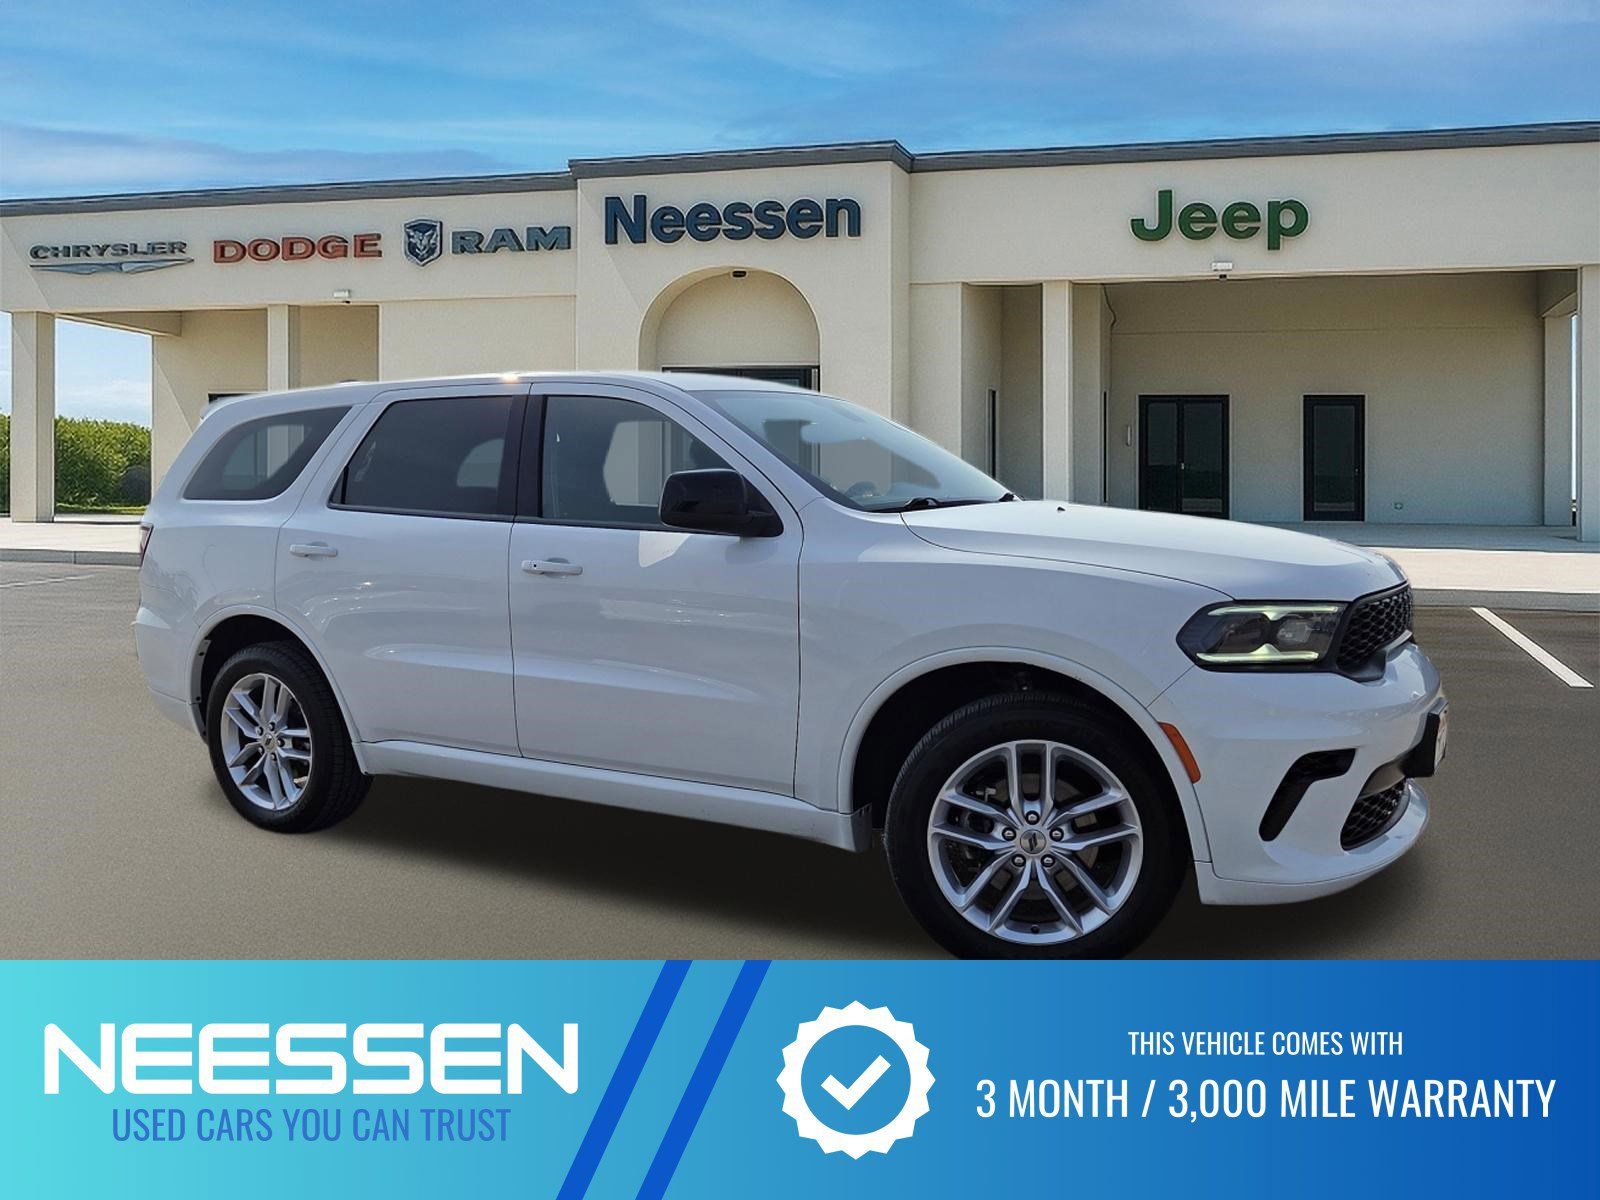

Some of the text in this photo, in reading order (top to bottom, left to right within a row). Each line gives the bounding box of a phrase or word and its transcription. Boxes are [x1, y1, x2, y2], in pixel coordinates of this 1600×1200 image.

[604, 194, 862, 245] Neessen
[1130, 189, 1310, 251] Jeep
[29, 240, 188, 260] CHRYSLER
[213, 233, 382, 264] DODGE
[451, 225, 571, 255] RAM
